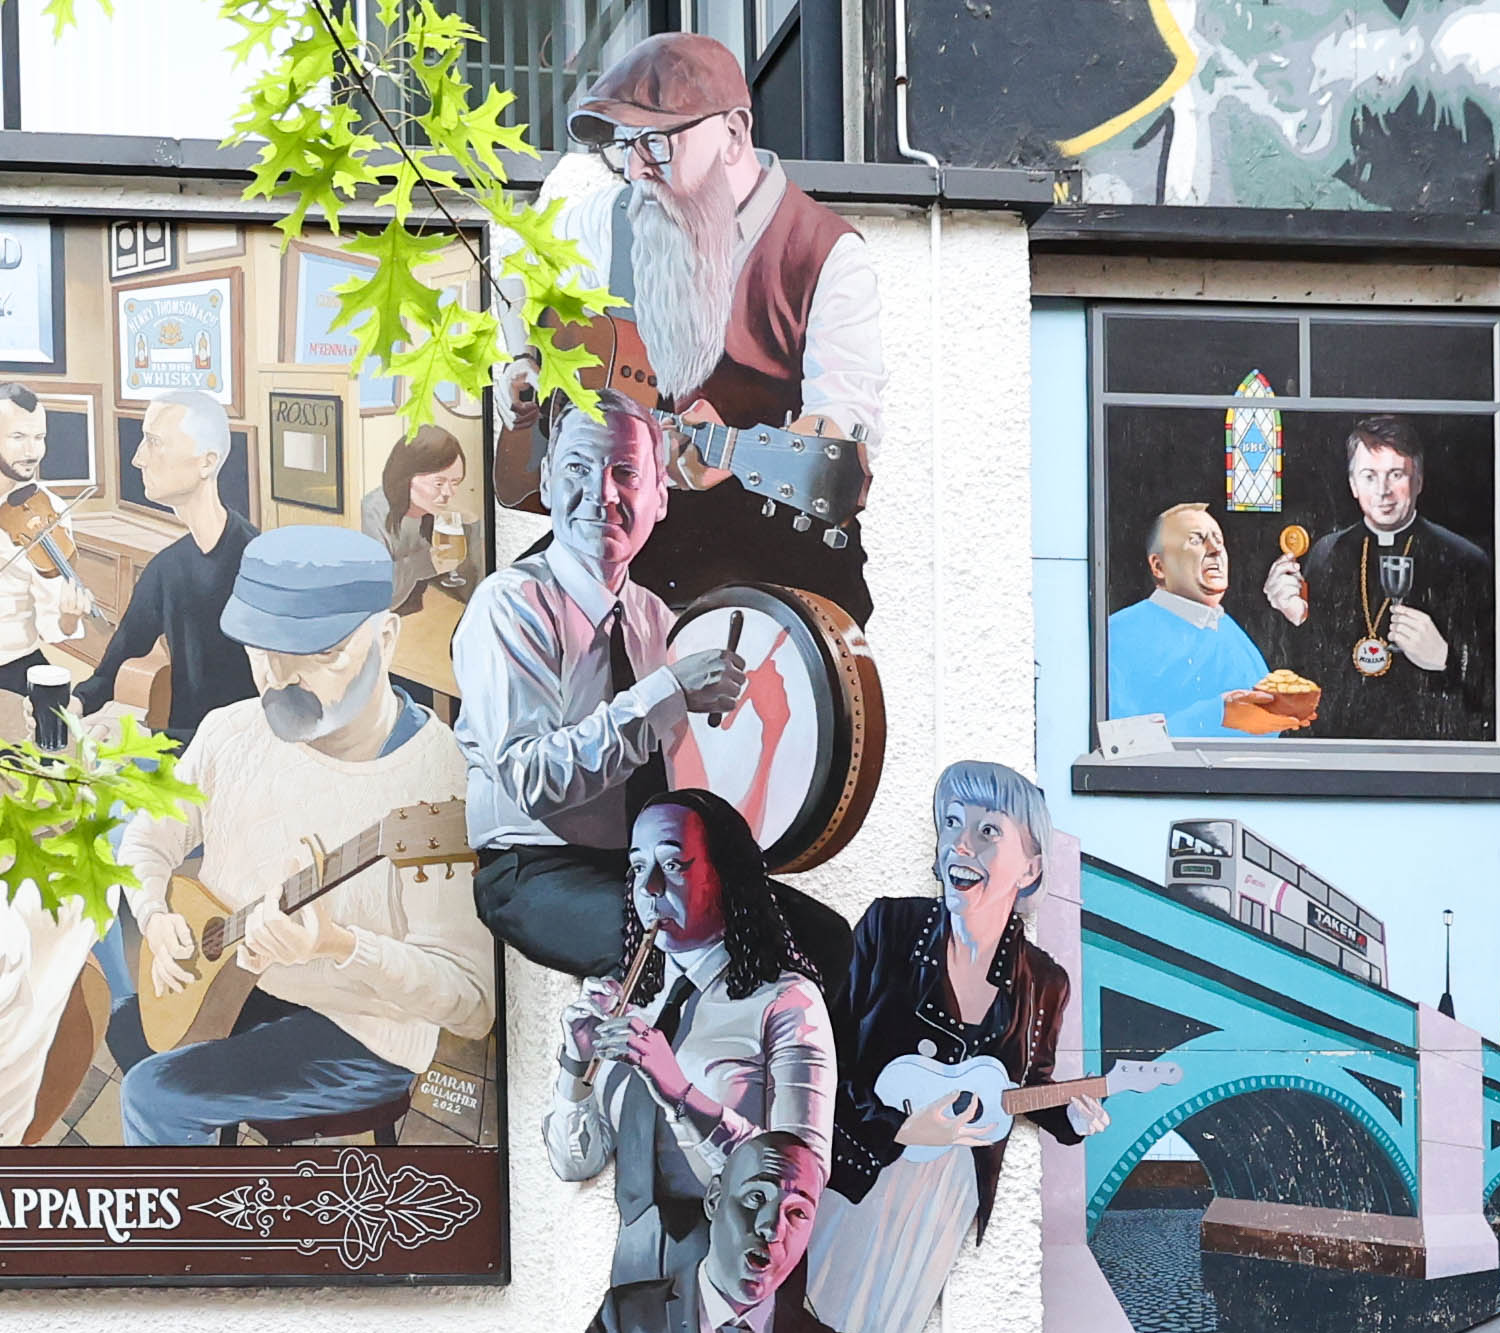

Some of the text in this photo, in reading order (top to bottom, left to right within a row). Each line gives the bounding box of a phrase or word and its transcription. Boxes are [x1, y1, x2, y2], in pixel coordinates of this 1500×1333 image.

[142, 372, 202, 386] WHISKY
[1242, 443, 1266, 452] BBC
[1315, 907, 1356, 942] TAKEN
[427, 1070, 476, 1095] CIARAN
[420, 1083, 478, 1109] GALLAGHER
[432, 1098, 462, 1115] 2022
